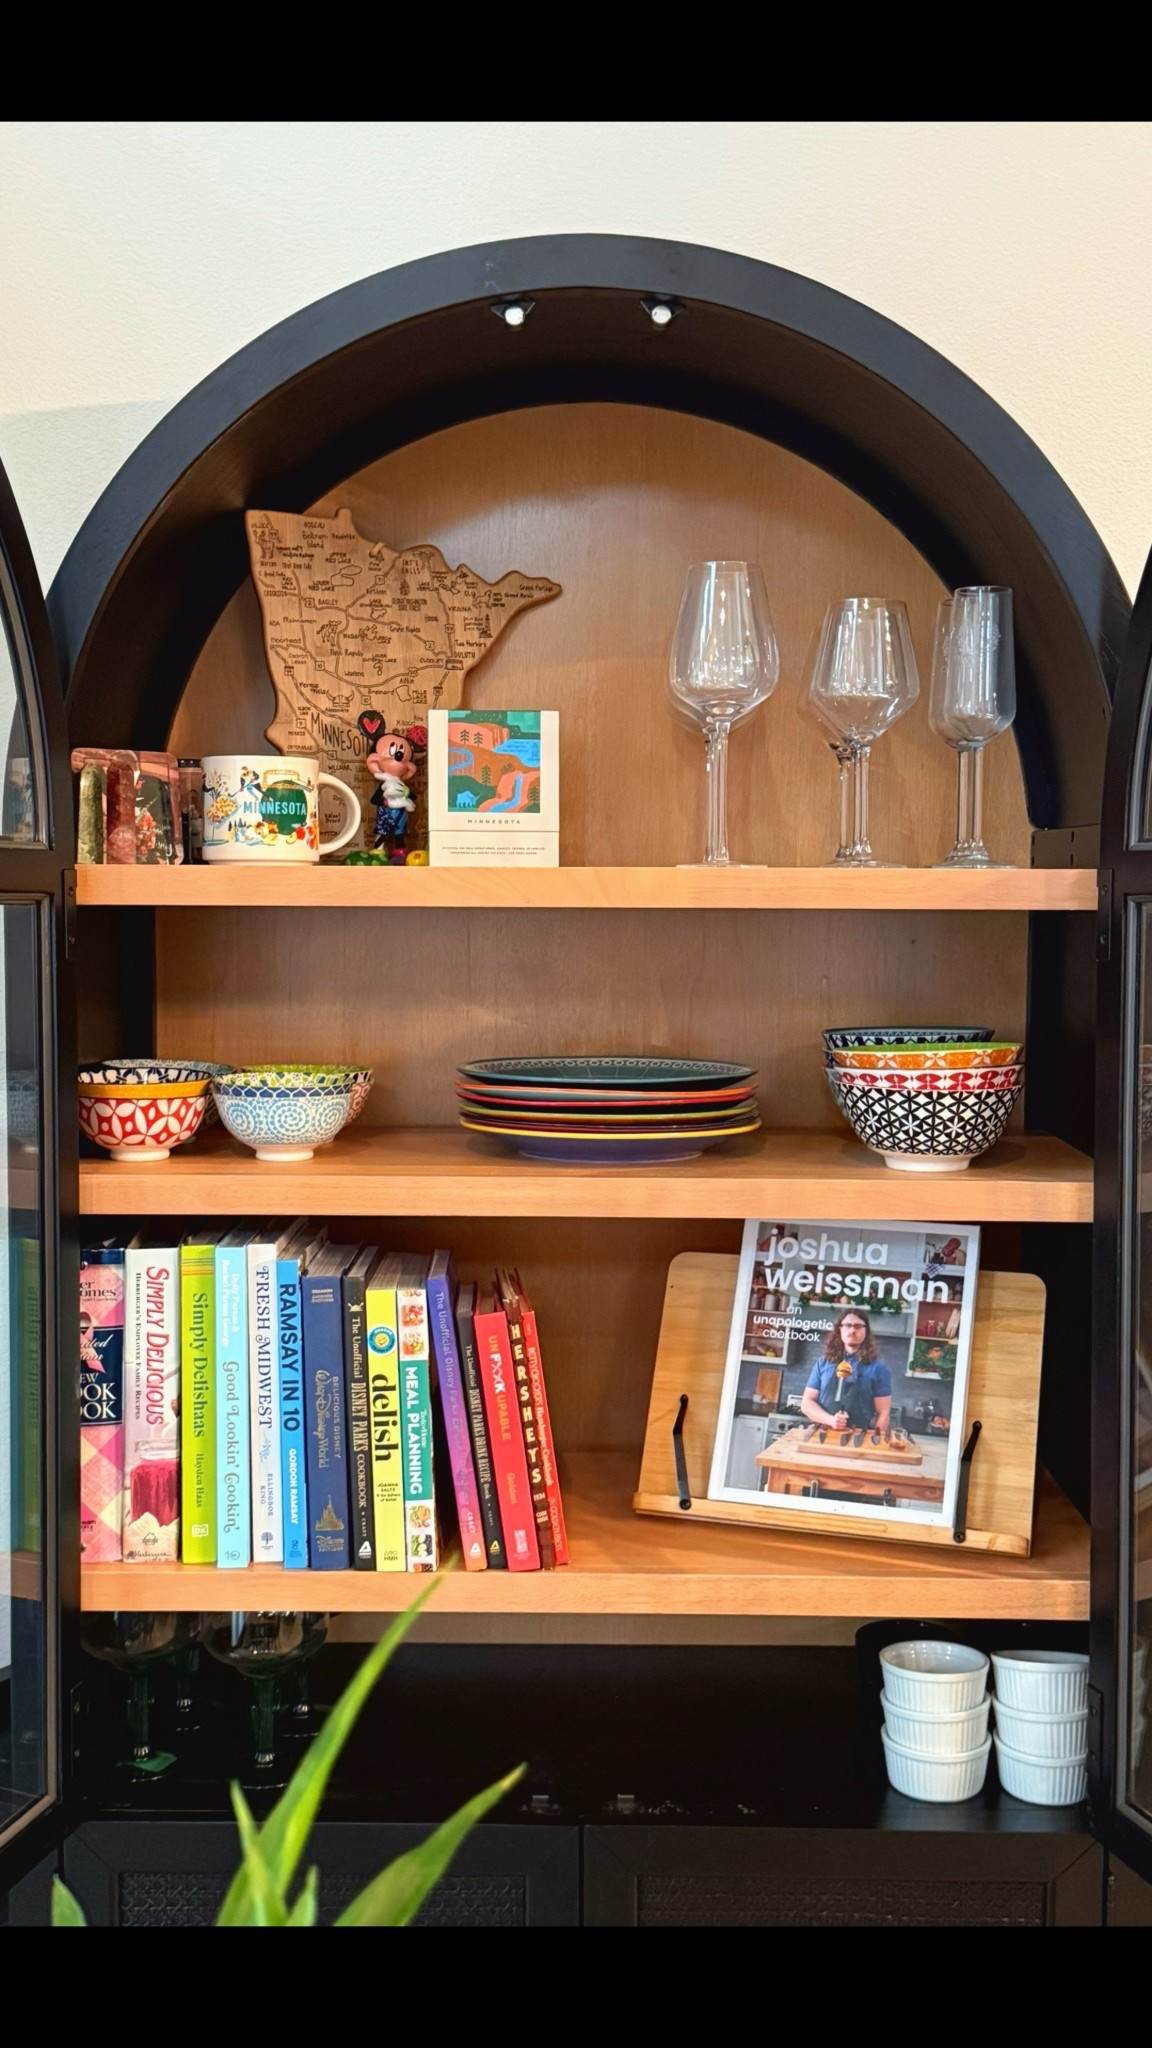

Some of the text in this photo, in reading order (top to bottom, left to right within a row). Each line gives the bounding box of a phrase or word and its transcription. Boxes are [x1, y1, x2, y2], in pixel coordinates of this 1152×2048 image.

[243, 800, 307, 816] MINNESOTA
[763, 1228, 888, 1266] joshua
[764, 1264, 949, 1303] weissman
[435, 1291, 445, 1310] The
[786, 1304, 802, 1315] an
[438, 1310, 452, 1356] Unofficial
[753, 1315, 834, 1331] unapologetic
[762, 1328, 821, 1342] cookbook
[145, 1266, 170, 1426] SIMPLY DELICIOUS
[255, 1265, 272, 1429] FRESH MIDWEST
[280, 1283, 301, 1432] RAMSAY IN 10
[465, 1344, 473, 1357] The
[80, 1373, 99, 1383] EW
[189, 1292, 209, 1438] Simply Delishaas
[443, 1357, 455, 1391] Disney
[467, 1358, 477, 1387] Unofficial
[80, 1383, 117, 1401] OK
[469, 1388, 483, 1413] DISNEY
[80, 1401, 117, 1420] OK
[332, 1376, 341, 1459] DELICIOUS DISNEY
[351, 1316, 369, 1508] The Unofficial DISNEY PARKS COOKBOOK
[371, 1373, 399, 1462] delish
[472, 1414, 485, 1436] PARKS
[405, 1366, 423, 1495] MEAL PLANNING
[475, 1436, 488, 1458] DRINK
[536, 1406, 548, 1449] Hamburger
[542, 1449, 554, 1486] Cookbook
[222, 1361, 240, 1534] Good Lookin' Cookin'
[318, 1438, 330, 1469] World
[194, 1453, 205, 1508] Hayden Haas
[288, 1448, 299, 1525] GORDON RAMSAY
[478, 1457, 492, 1483] RECIPE
[507, 1472, 517, 1505] Golden
